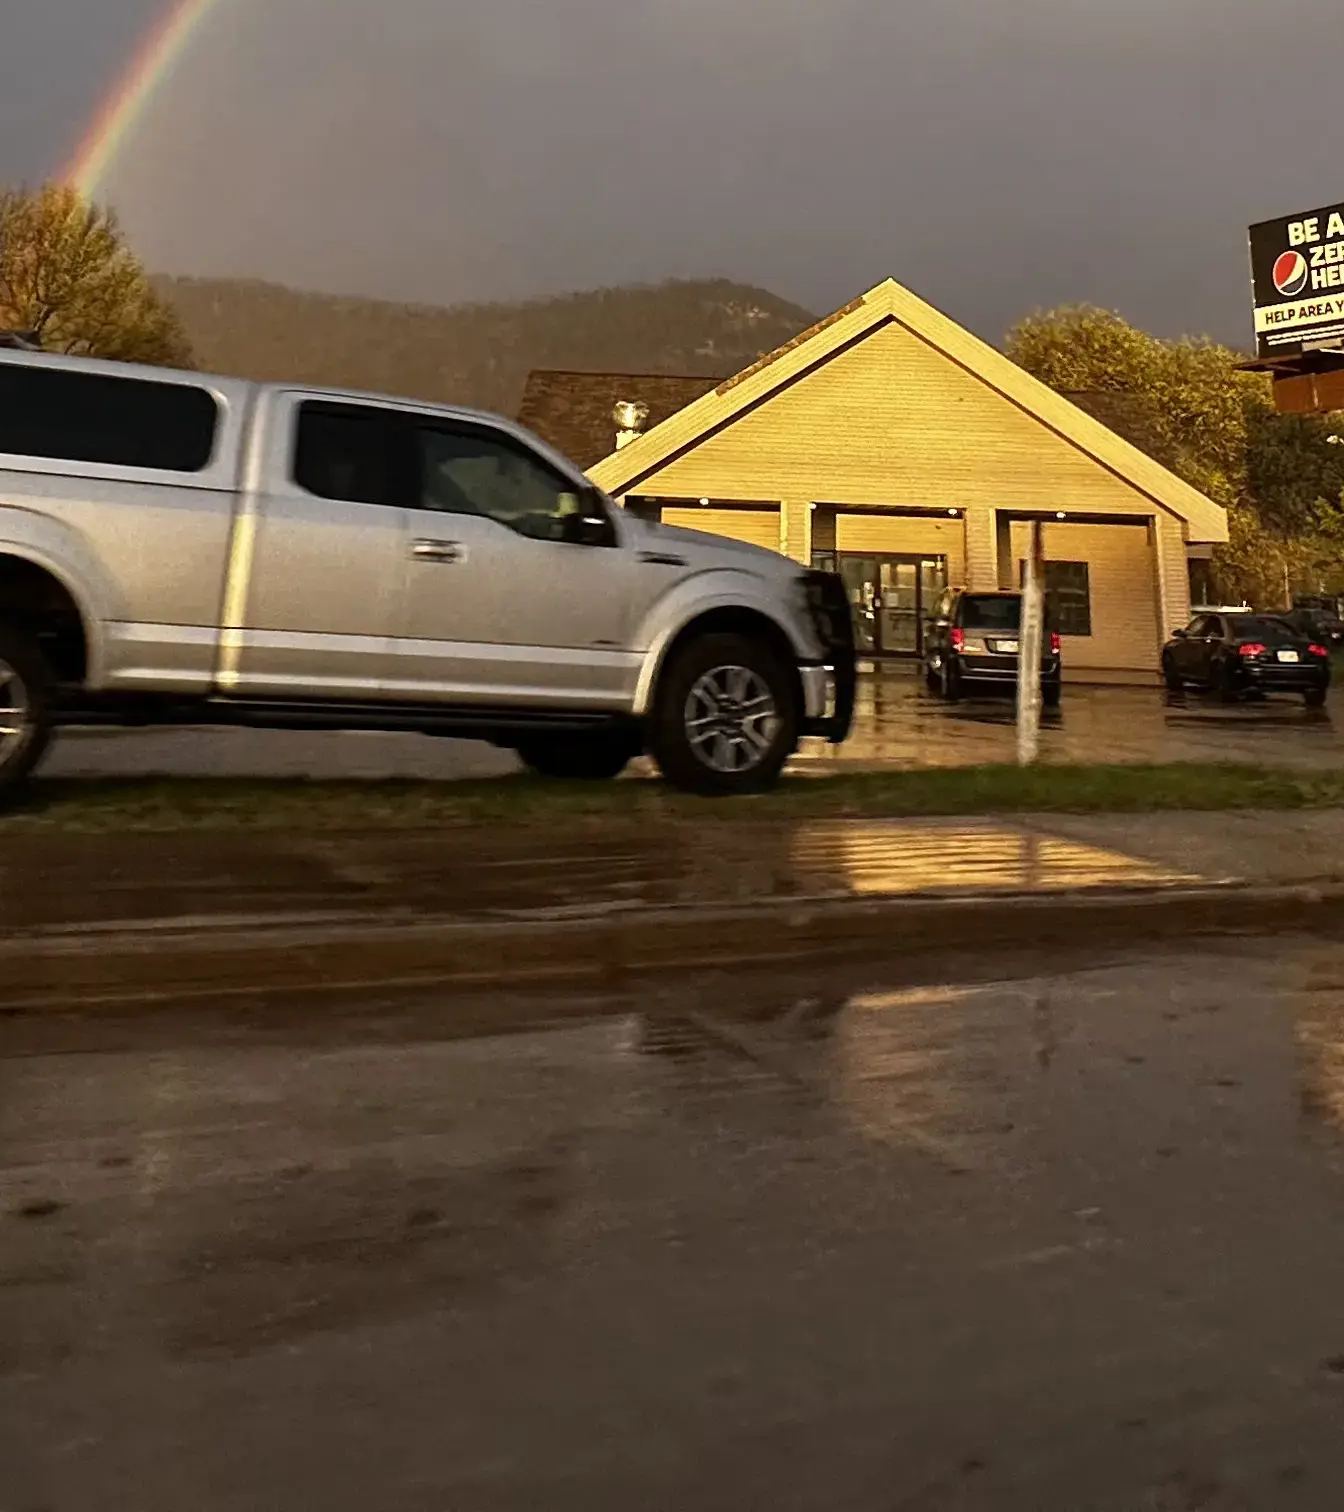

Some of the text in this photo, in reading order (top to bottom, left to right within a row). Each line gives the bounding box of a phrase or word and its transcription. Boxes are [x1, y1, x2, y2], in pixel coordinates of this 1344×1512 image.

[1287, 217, 1320, 246] BE
[1265, 309, 1295, 324] HELP
[1298, 302, 1333, 319] AREA
